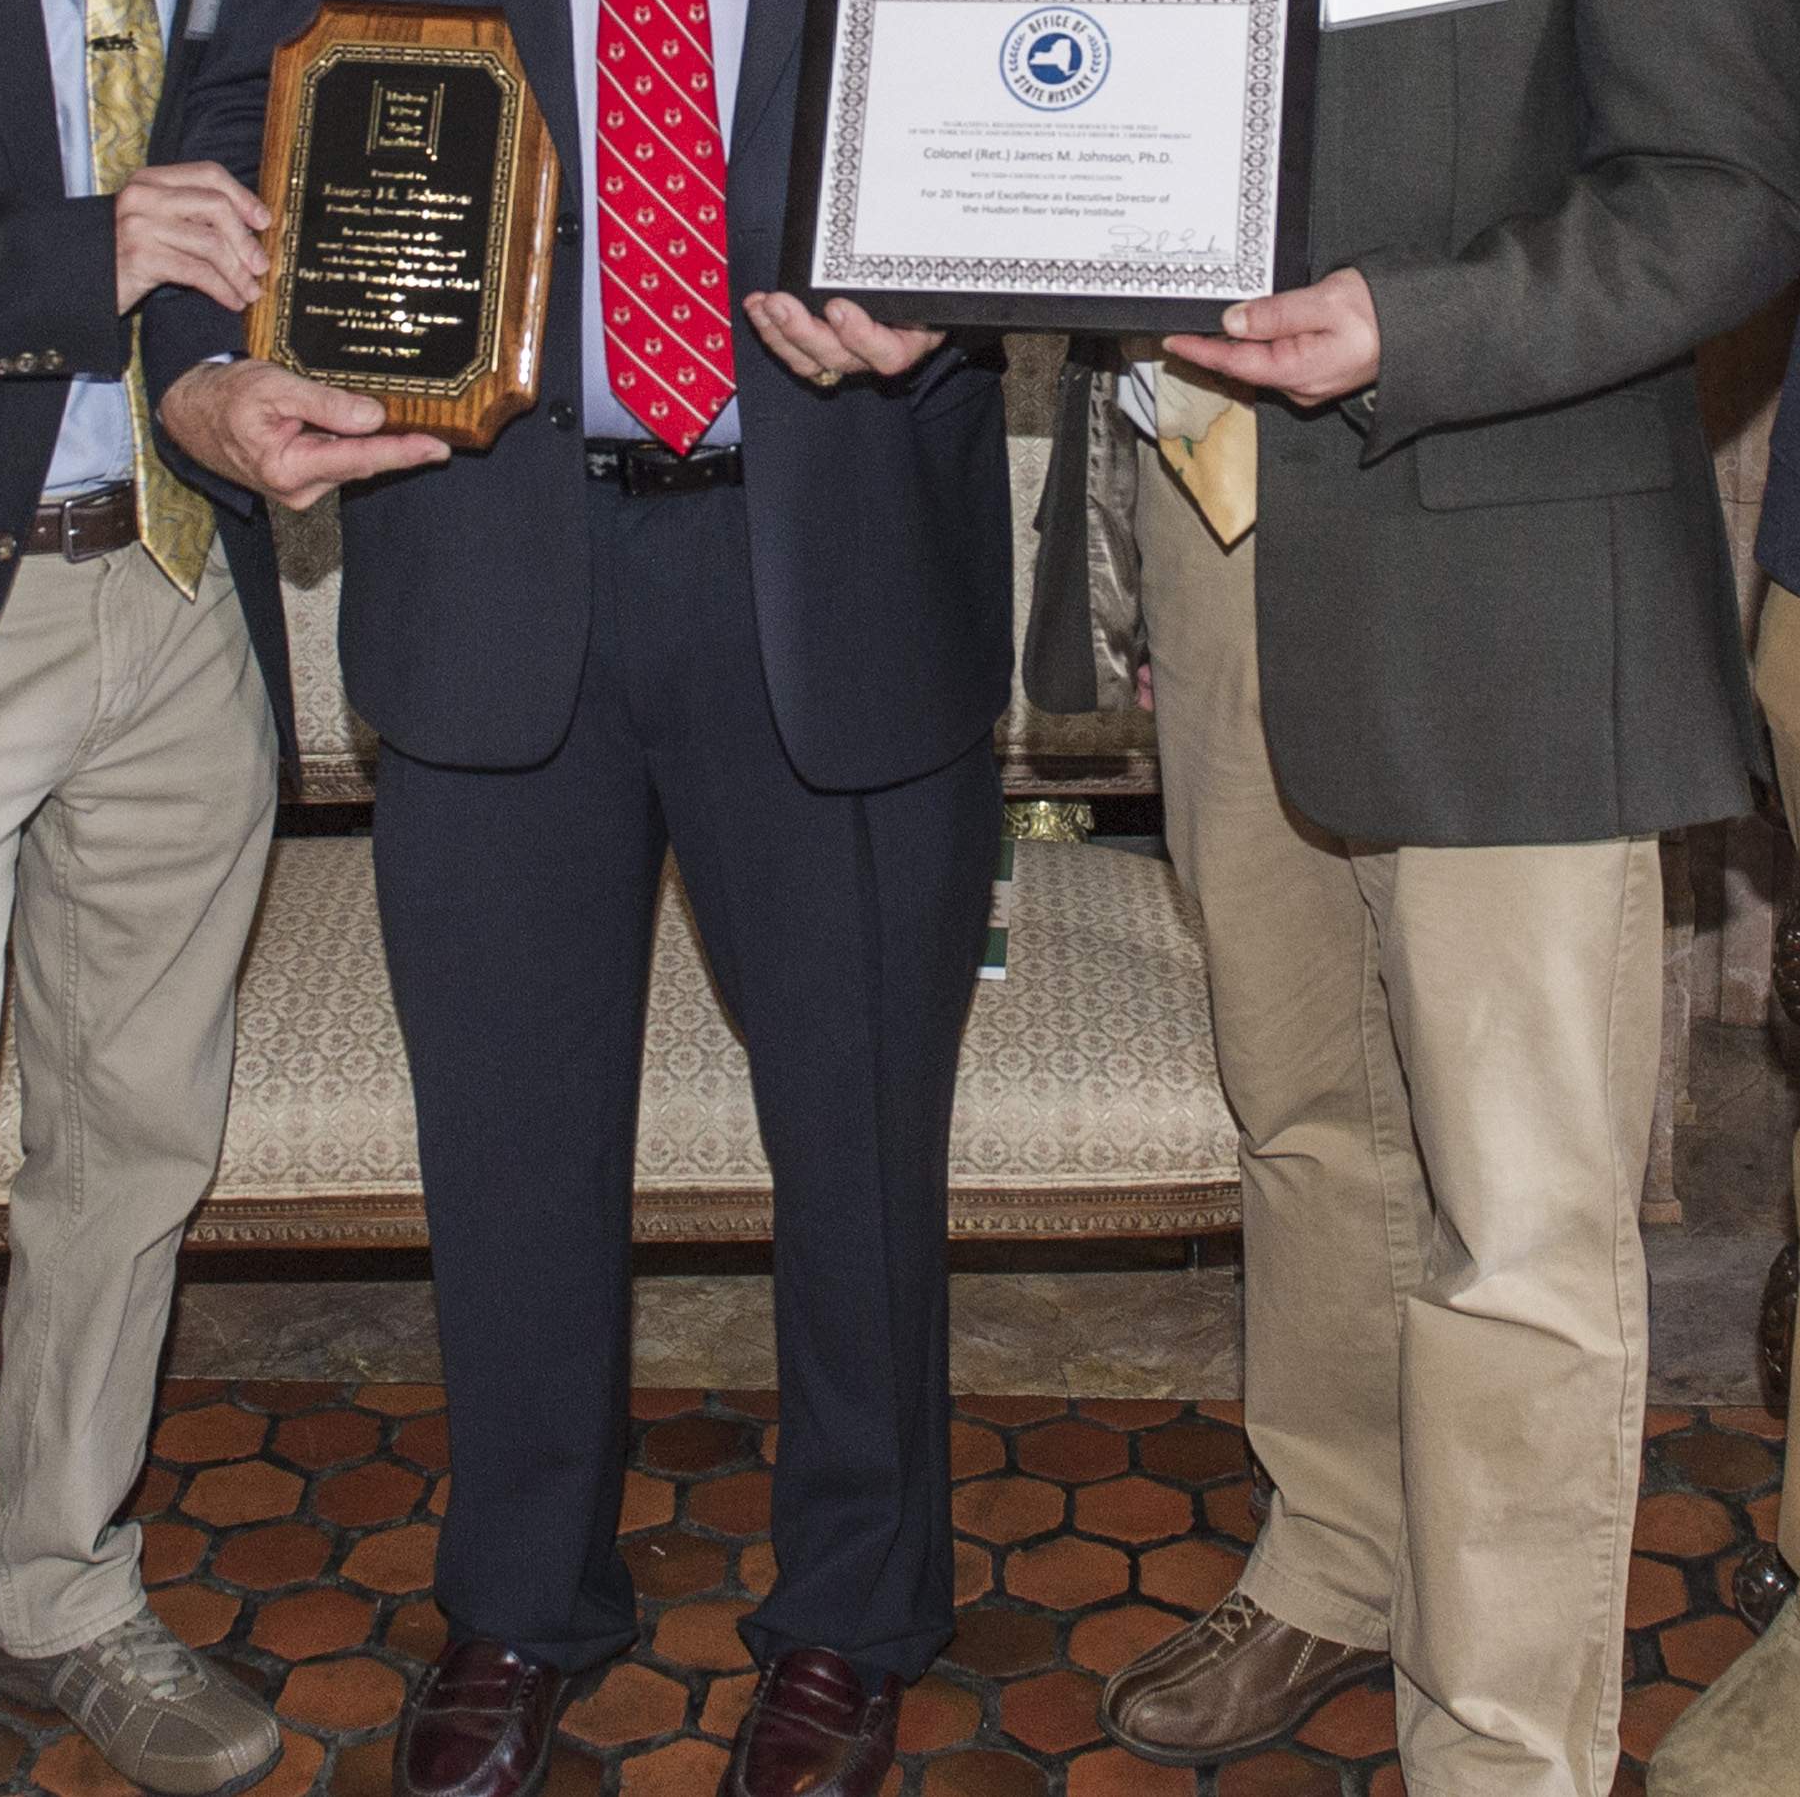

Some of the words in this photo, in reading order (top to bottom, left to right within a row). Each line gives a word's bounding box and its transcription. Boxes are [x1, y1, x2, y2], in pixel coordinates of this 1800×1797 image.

[1028, 14, 1071, 34] OFFICE
[1072, 20, 1088, 33] OF
[1014, 74, 1045, 102] STATE
[1048, 74, 1094, 103] HISTORY
[386, 90, 428, 103] Hudson
[923, 147, 973, 160] Colonel
[975, 147, 1011, 162] (Ret.)
[1014, 149, 1053, 161] James
[1057, 150, 1074, 161] M.
[1078, 150, 1135, 164] Johnson,
[1138, 151, 1173, 163] Ph.D.
[920, 189, 937, 199] For
[940, 189, 953, 199] 20
[955, 190, 982, 200] Years
[984, 190, 995, 199] of
[997, 190, 1049, 201] Excellence
[1052, 193, 1063, 201] as
[1065, 192, 1113, 202] Executive
[1115, 193, 1156, 203] Director
[1158, 193, 1170, 203] of
[962, 204, 979, 213] the
[981, 204, 1020, 214] Hudson
[1022, 205, 1047, 215] River
[1050, 206, 1080, 217] Valley
[1083, 207, 1126, 217] Institute
